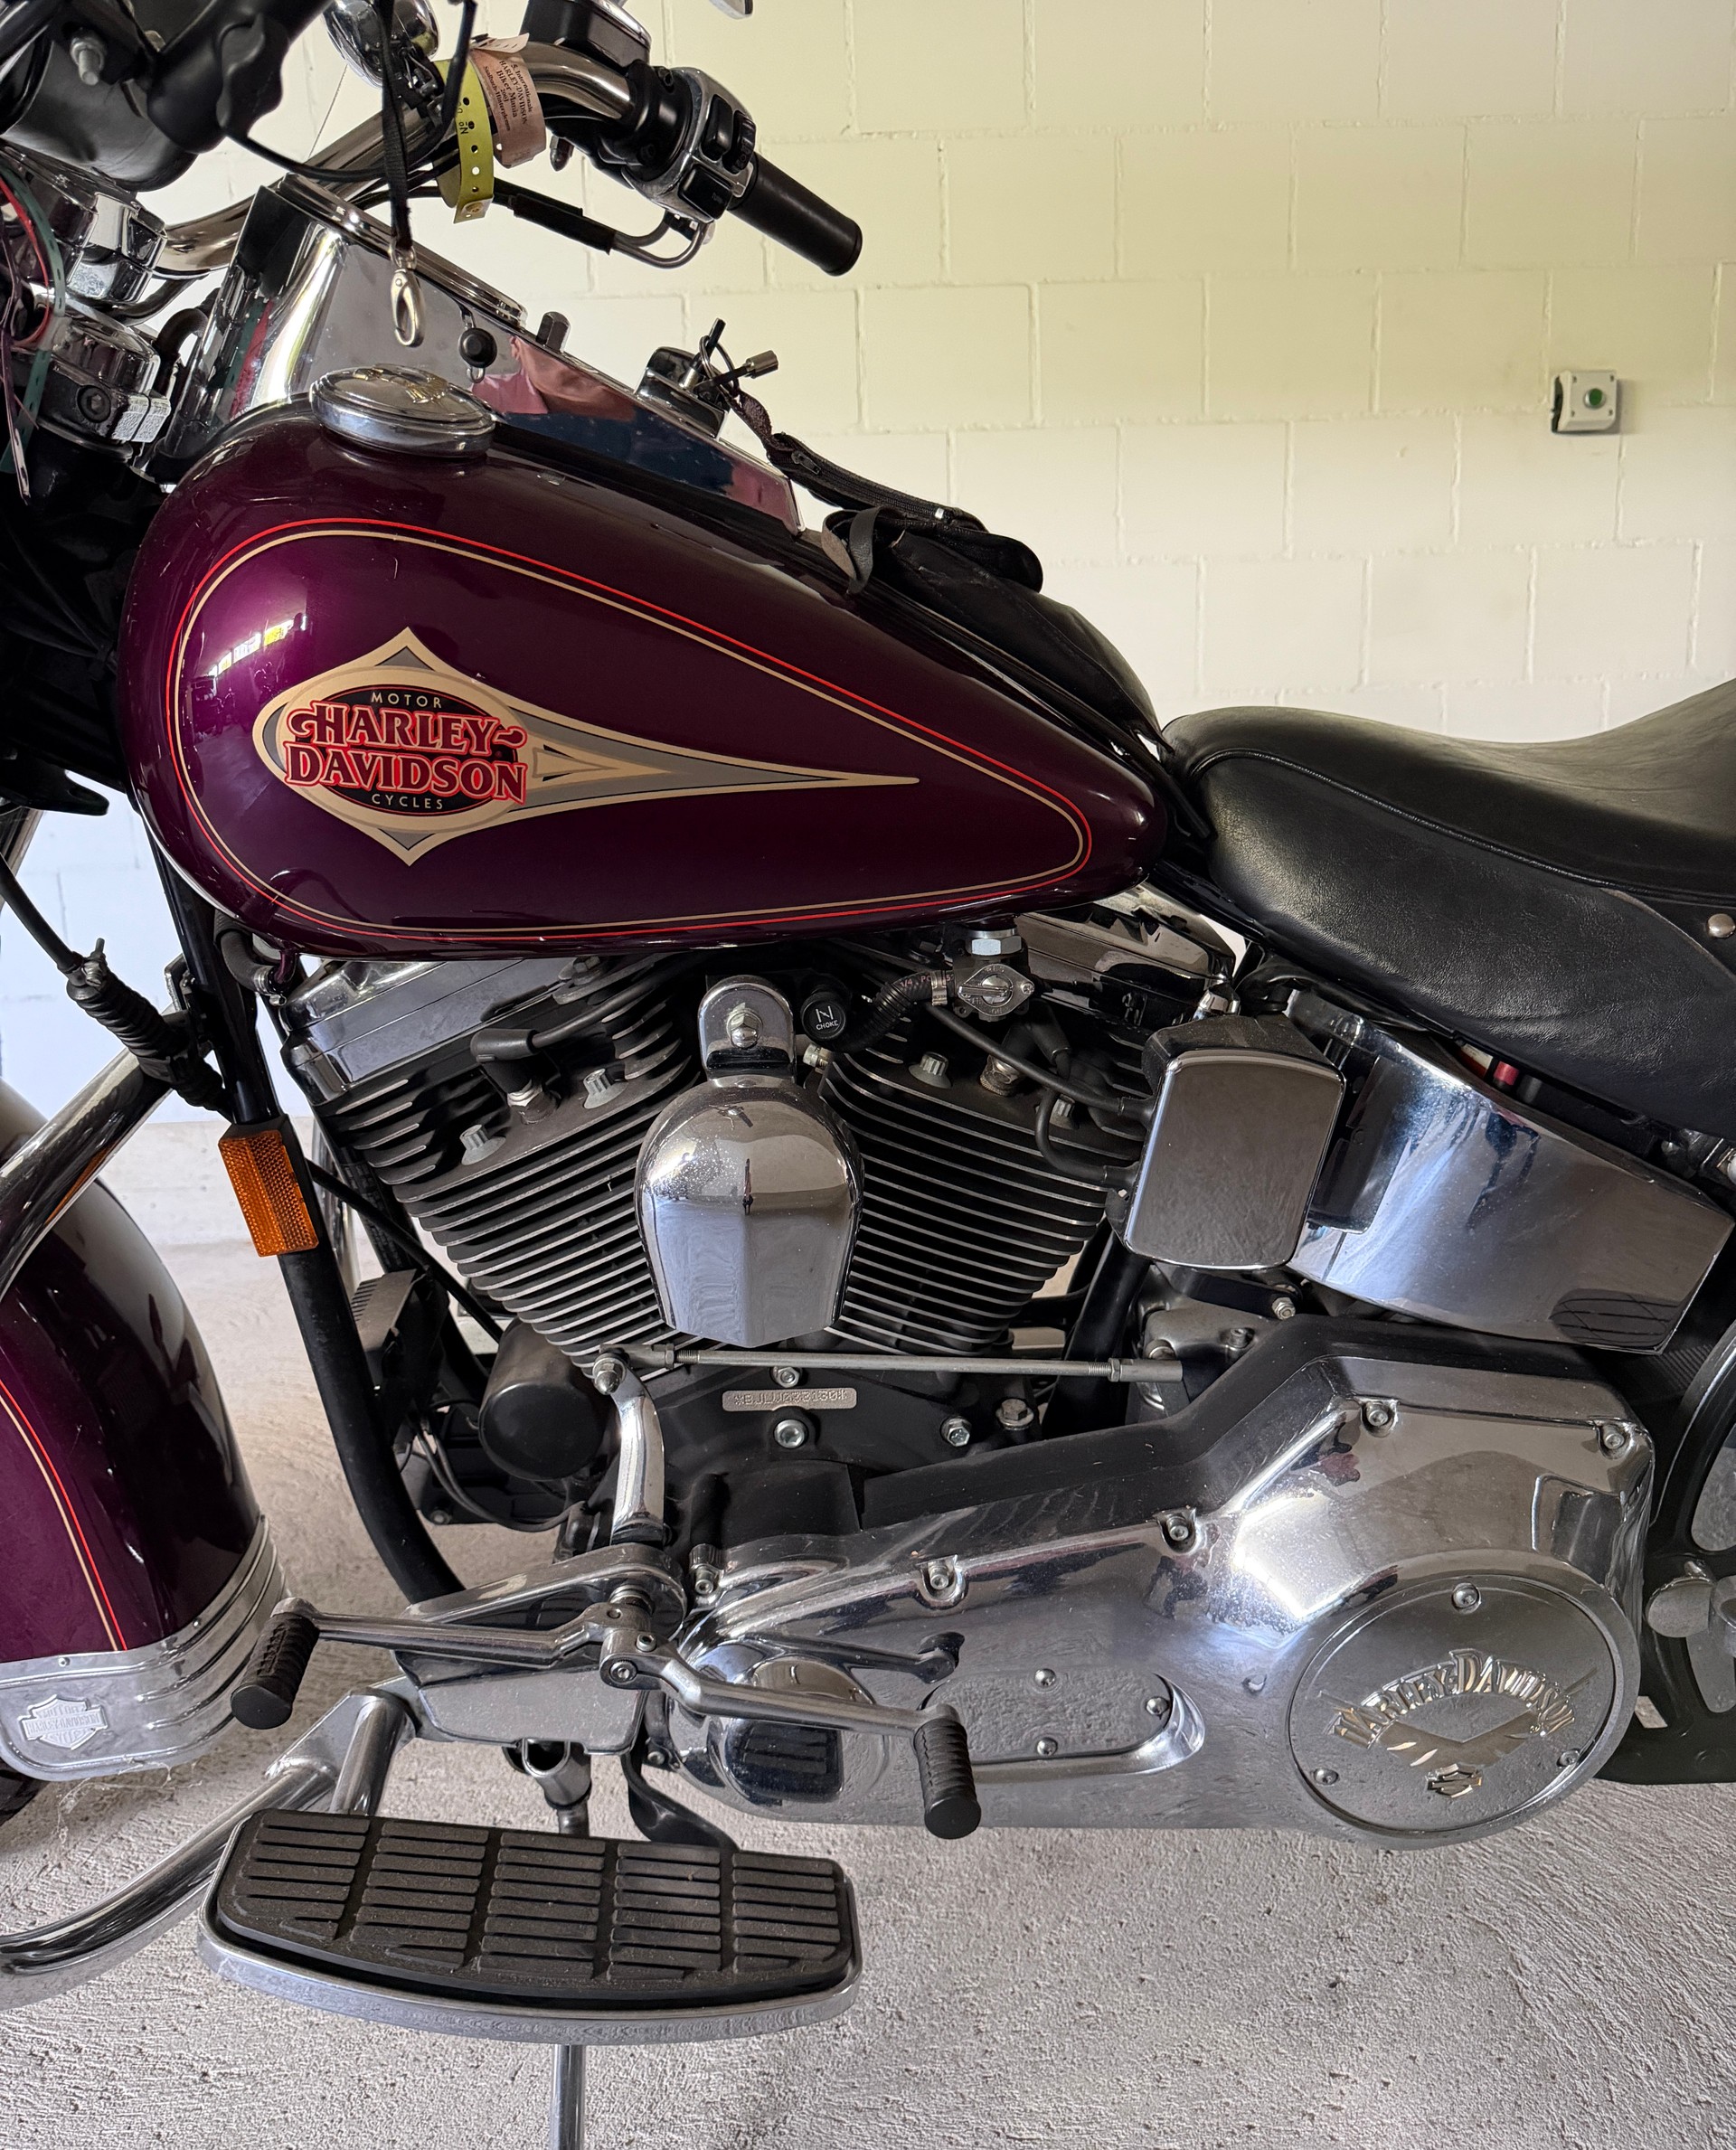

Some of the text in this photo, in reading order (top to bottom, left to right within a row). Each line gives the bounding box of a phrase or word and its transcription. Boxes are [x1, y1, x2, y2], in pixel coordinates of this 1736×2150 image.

[495, 70, 518, 118] Biker Mania
[499, 60, 528, 125] HARLEY-DAVIDSON
[371, 692, 442, 709] MOTOR
[283, 740, 528, 806] DAVIDSON
[371, 793, 443, 810] CYCLES
[816, 1020, 839, 1031] CHOKE
